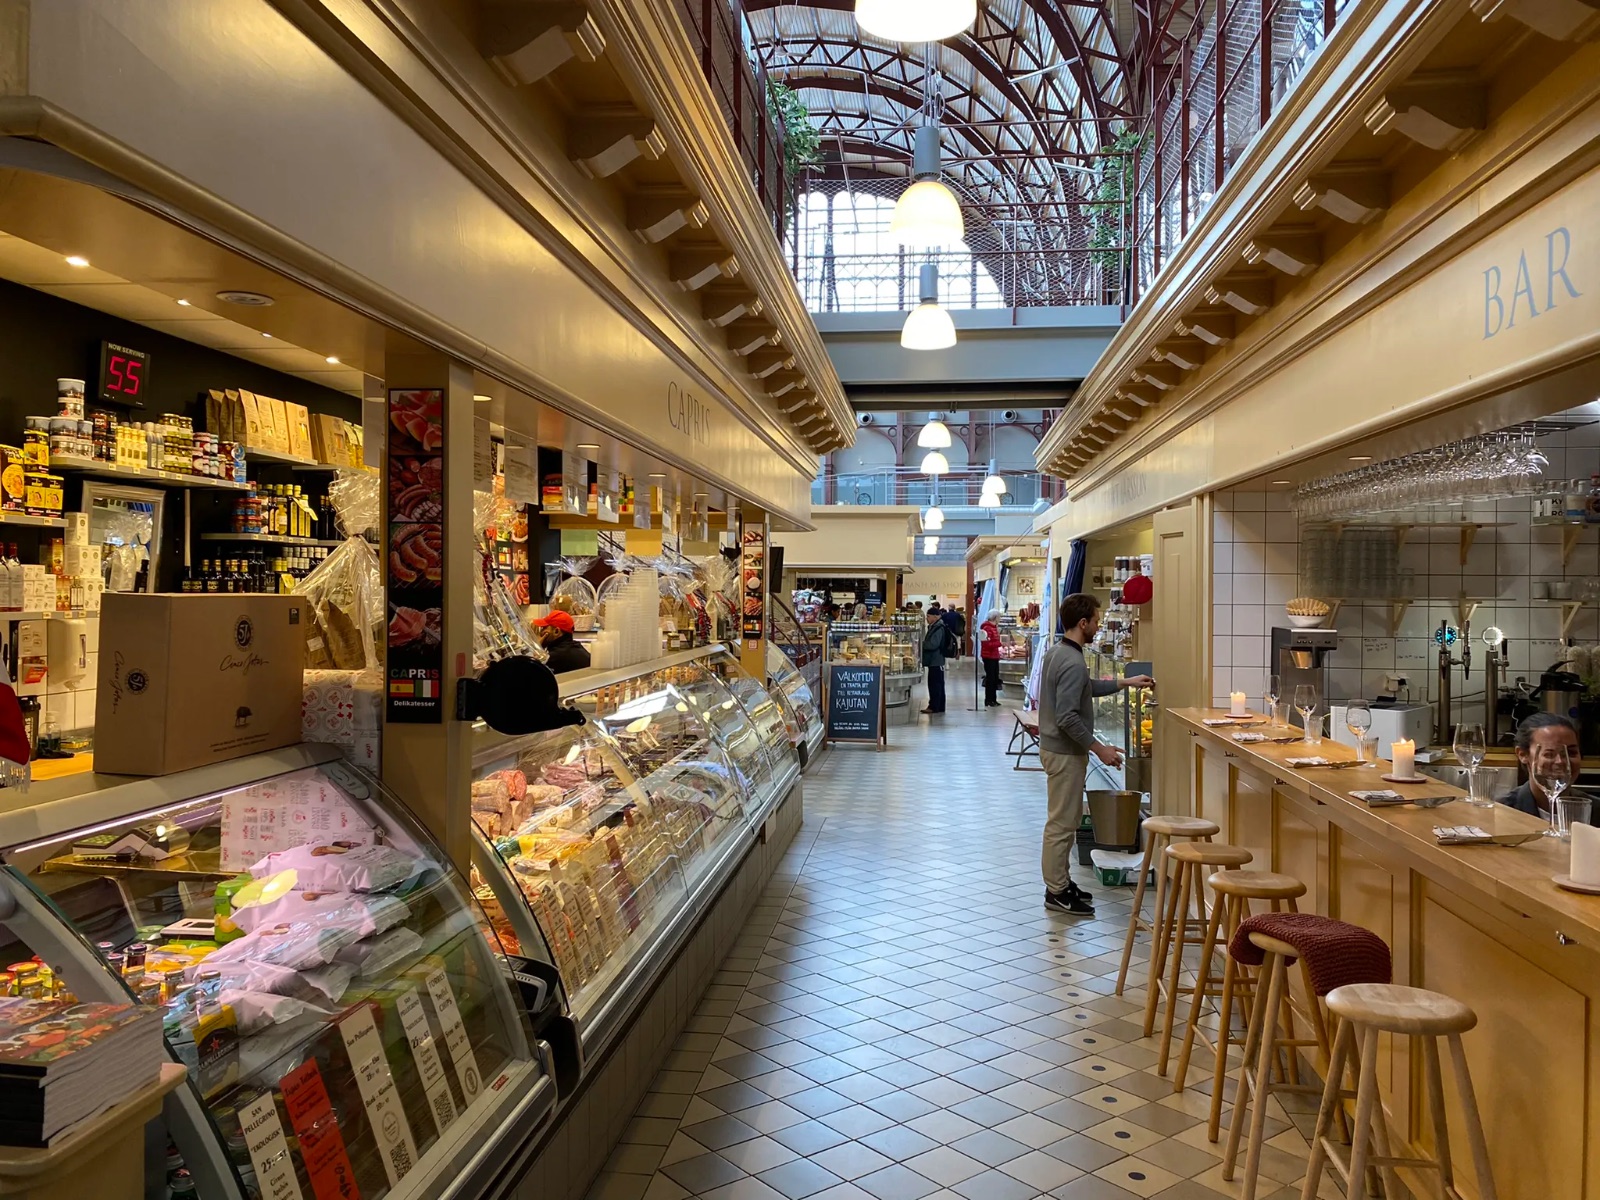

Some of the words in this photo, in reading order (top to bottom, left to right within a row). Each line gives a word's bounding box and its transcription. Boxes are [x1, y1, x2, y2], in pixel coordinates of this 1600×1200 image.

[1482, 226, 1583, 341] BAR
[108, 342, 122, 351] NOW
[122, 346, 145, 359] SERVING
[107, 355, 142, 395] 55
[667, 380, 711, 449] CAPRIS
[943, 581, 965, 589] SHOP
[390, 668, 440, 679] CAPRIS
[835, 698, 868, 711] KAJUTAN
[428, 973, 446, 988] TORRES
[251, 1105, 263, 1118] SAN
[244, 1108, 276, 1136] PELLEGRINO
